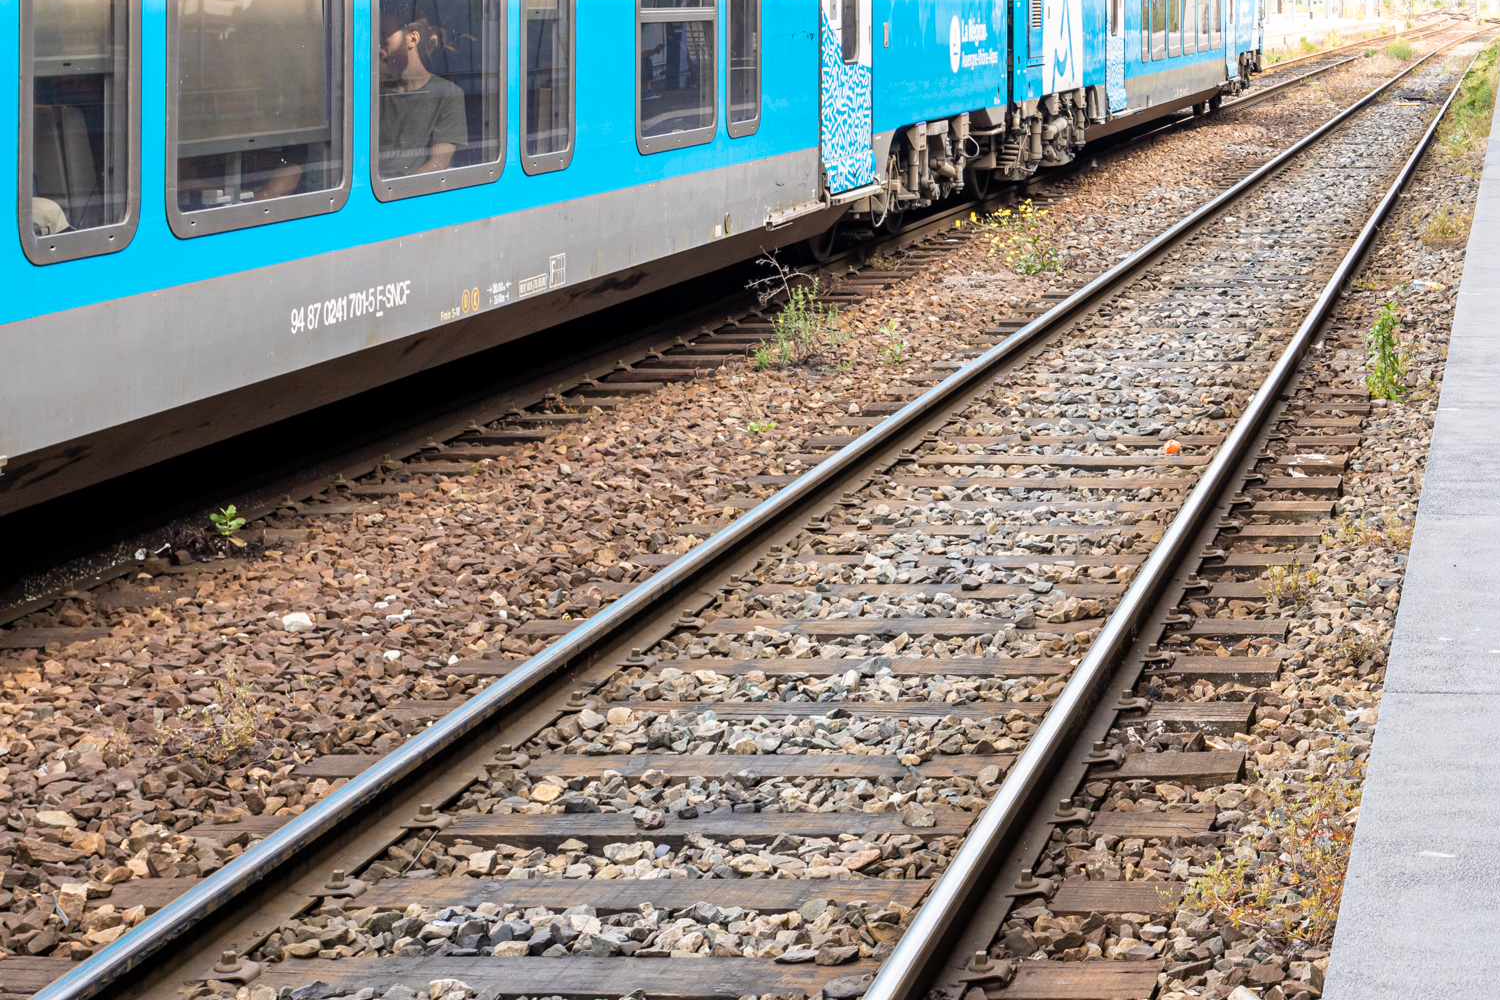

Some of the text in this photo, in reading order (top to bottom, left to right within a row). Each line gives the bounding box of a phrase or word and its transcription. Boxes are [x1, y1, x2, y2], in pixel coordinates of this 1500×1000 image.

[961, 19, 968, 42] La
[291, 306, 305, 334] 94
[307, 302, 321, 330] 87
[323, 296, 347, 326] 0241
